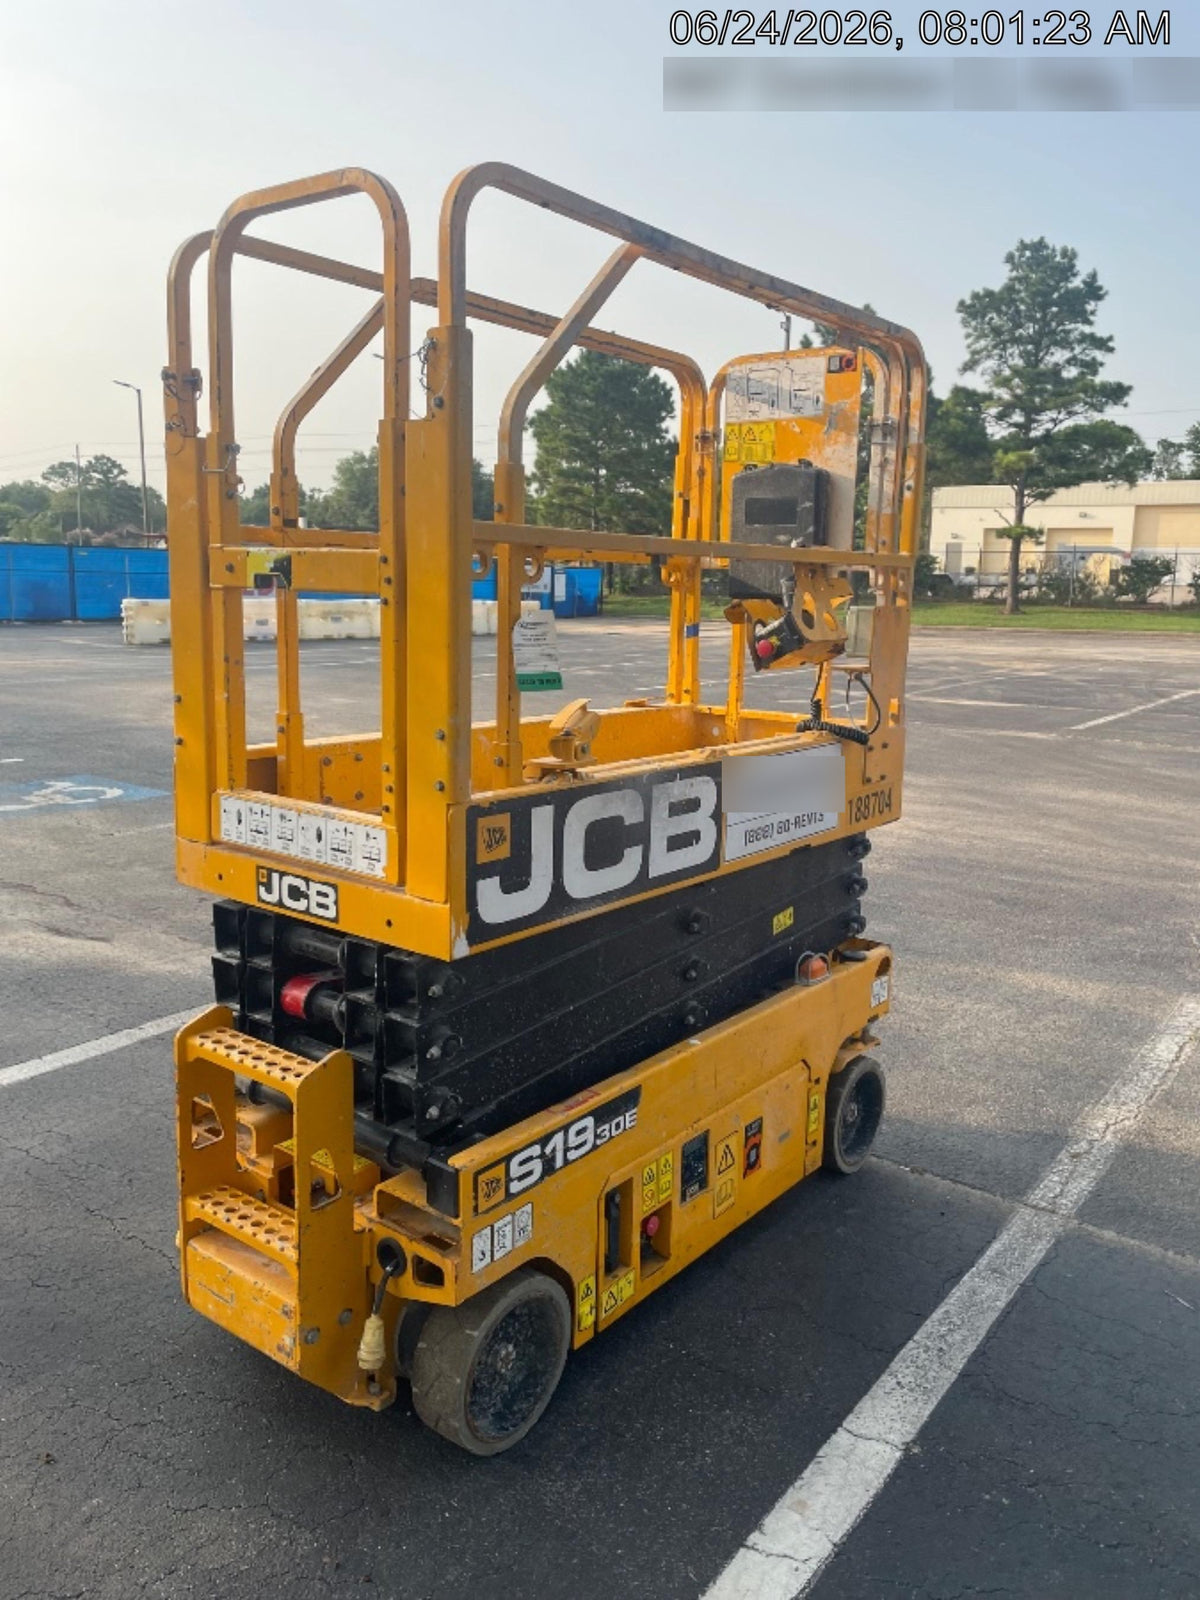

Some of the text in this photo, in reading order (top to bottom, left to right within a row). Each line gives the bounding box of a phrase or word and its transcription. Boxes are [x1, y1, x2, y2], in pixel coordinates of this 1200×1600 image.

[848, 787, 892, 825] 188704
[476, 774, 718, 924] JCB
[258, 872, 337, 920] JCB
